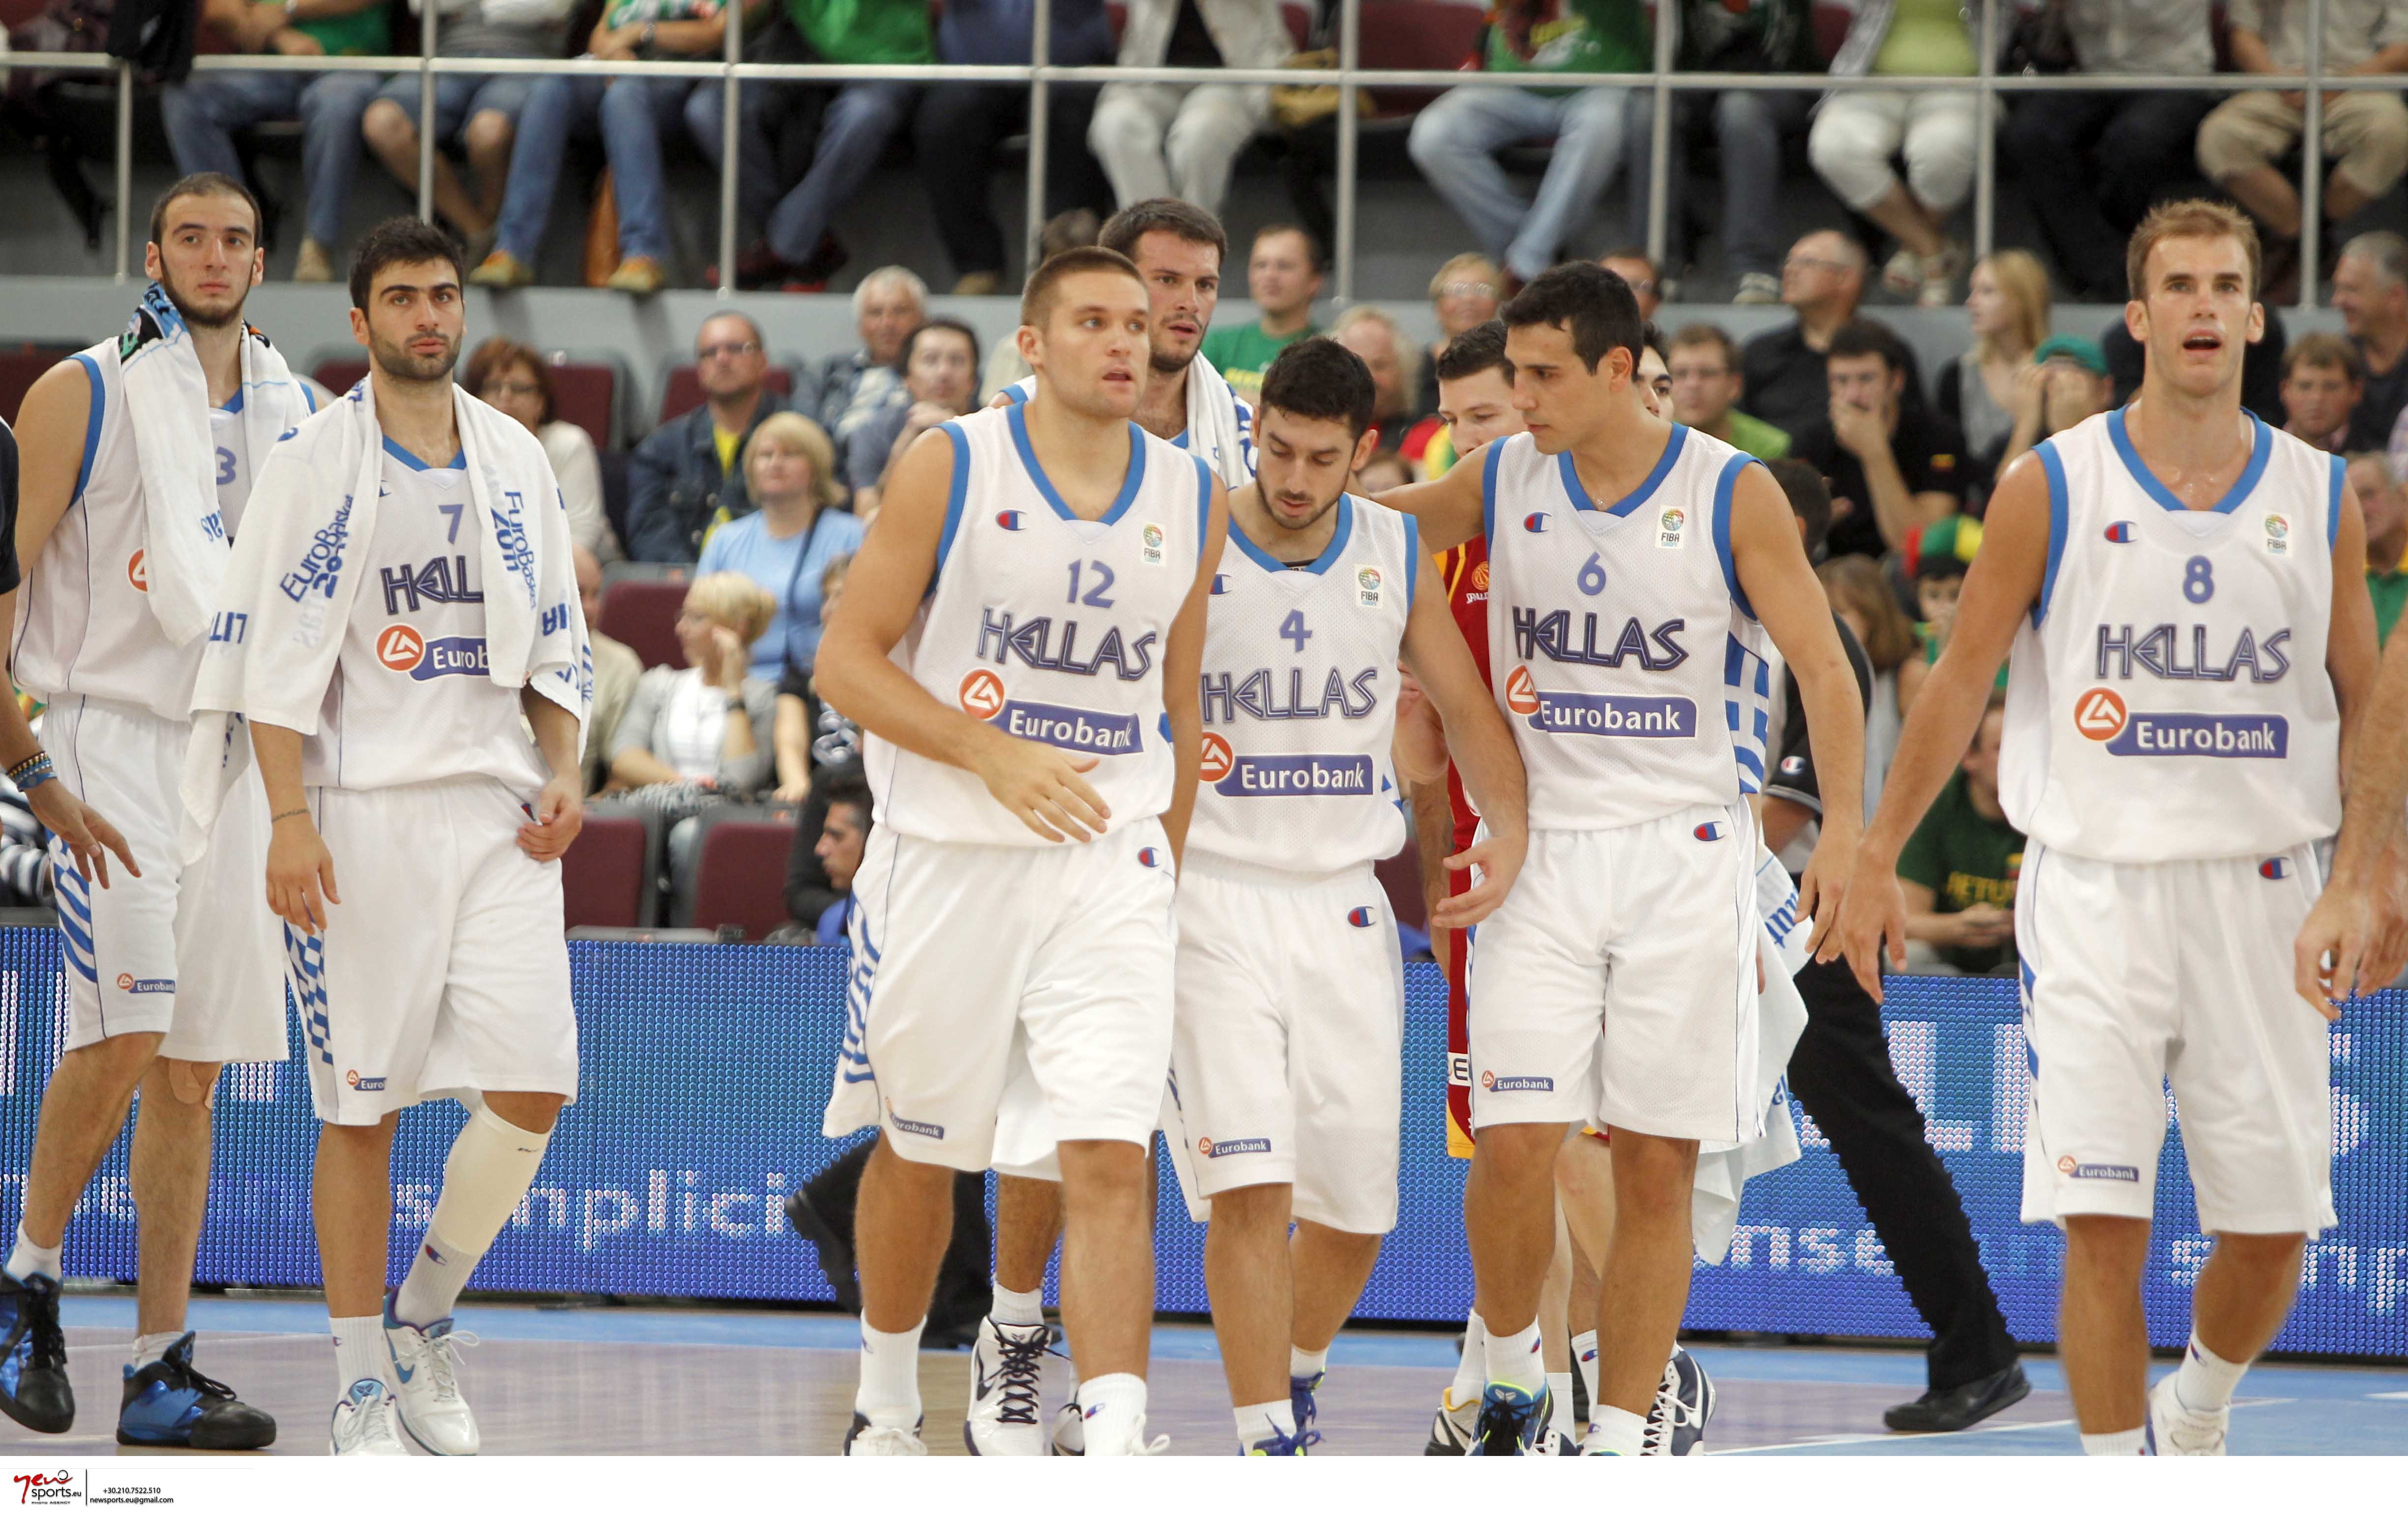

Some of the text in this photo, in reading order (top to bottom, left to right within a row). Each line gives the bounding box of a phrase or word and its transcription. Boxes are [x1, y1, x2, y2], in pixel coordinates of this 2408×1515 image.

[439, 504, 464, 545] 7
[1661, 532, 1680, 542] FIBA
[1144, 547, 1160, 559] FIBA
[381, 555, 484, 615] HELL
[1067, 558, 1116, 608] 12
[1577, 551, 1606, 596] 6
[2183, 555, 2214, 604] 8
[1361, 591, 1378, 601] FIBA
[976, 607, 1156, 681] HELLAS
[1279, 608, 1312, 653] 4
[1511, 606, 1689, 671] HELLAS
[432, 644, 489, 669] Eurob
[2096, 624, 2291, 683] HELLAS
[1201, 666, 1378, 724] HELLAS
[1008, 712, 1132, 749] Eurobank
[1540, 700, 1681, 731] Eurobank
[2136, 722, 2276, 752] Eurobank
[1241, 762, 1365, 790] Eurobank
[361, 1080, 385, 1090] Euro
[1497, 1079, 1549, 1090] Eurobank
[1215, 1141, 1267, 1154] Eurobank
[2079, 1166, 2136, 1181] Eurobank
